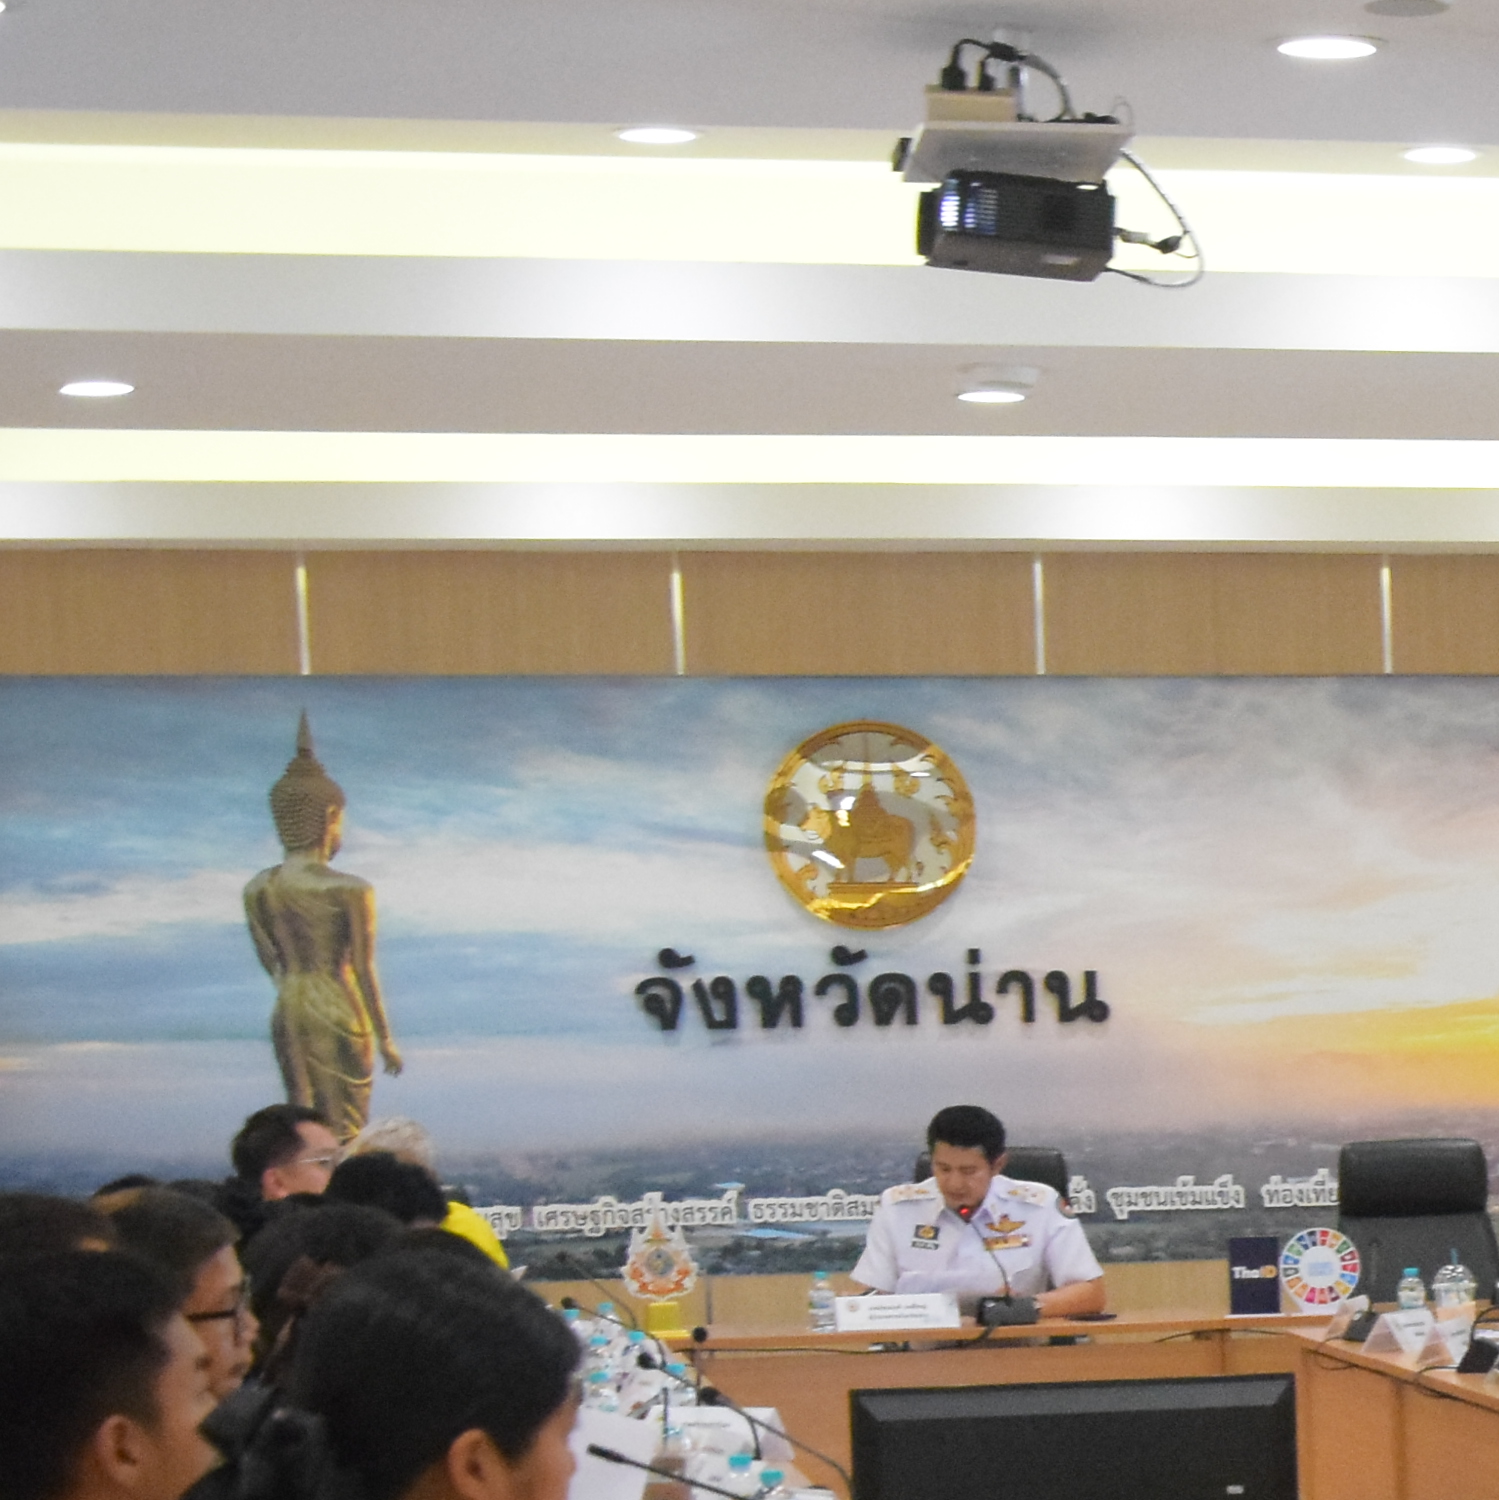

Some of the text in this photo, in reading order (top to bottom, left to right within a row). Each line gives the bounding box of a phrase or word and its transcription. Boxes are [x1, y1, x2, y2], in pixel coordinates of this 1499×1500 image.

[635, 945, 1110, 1030] จังหวัดน่าน
[749, 1189, 881, 1222] ธรรมชาติสม
[1106, 1174, 1245, 1219] ชุมชนเข้มแข็ง
[1261, 1168, 1339, 1207] ท่องเที่ย
